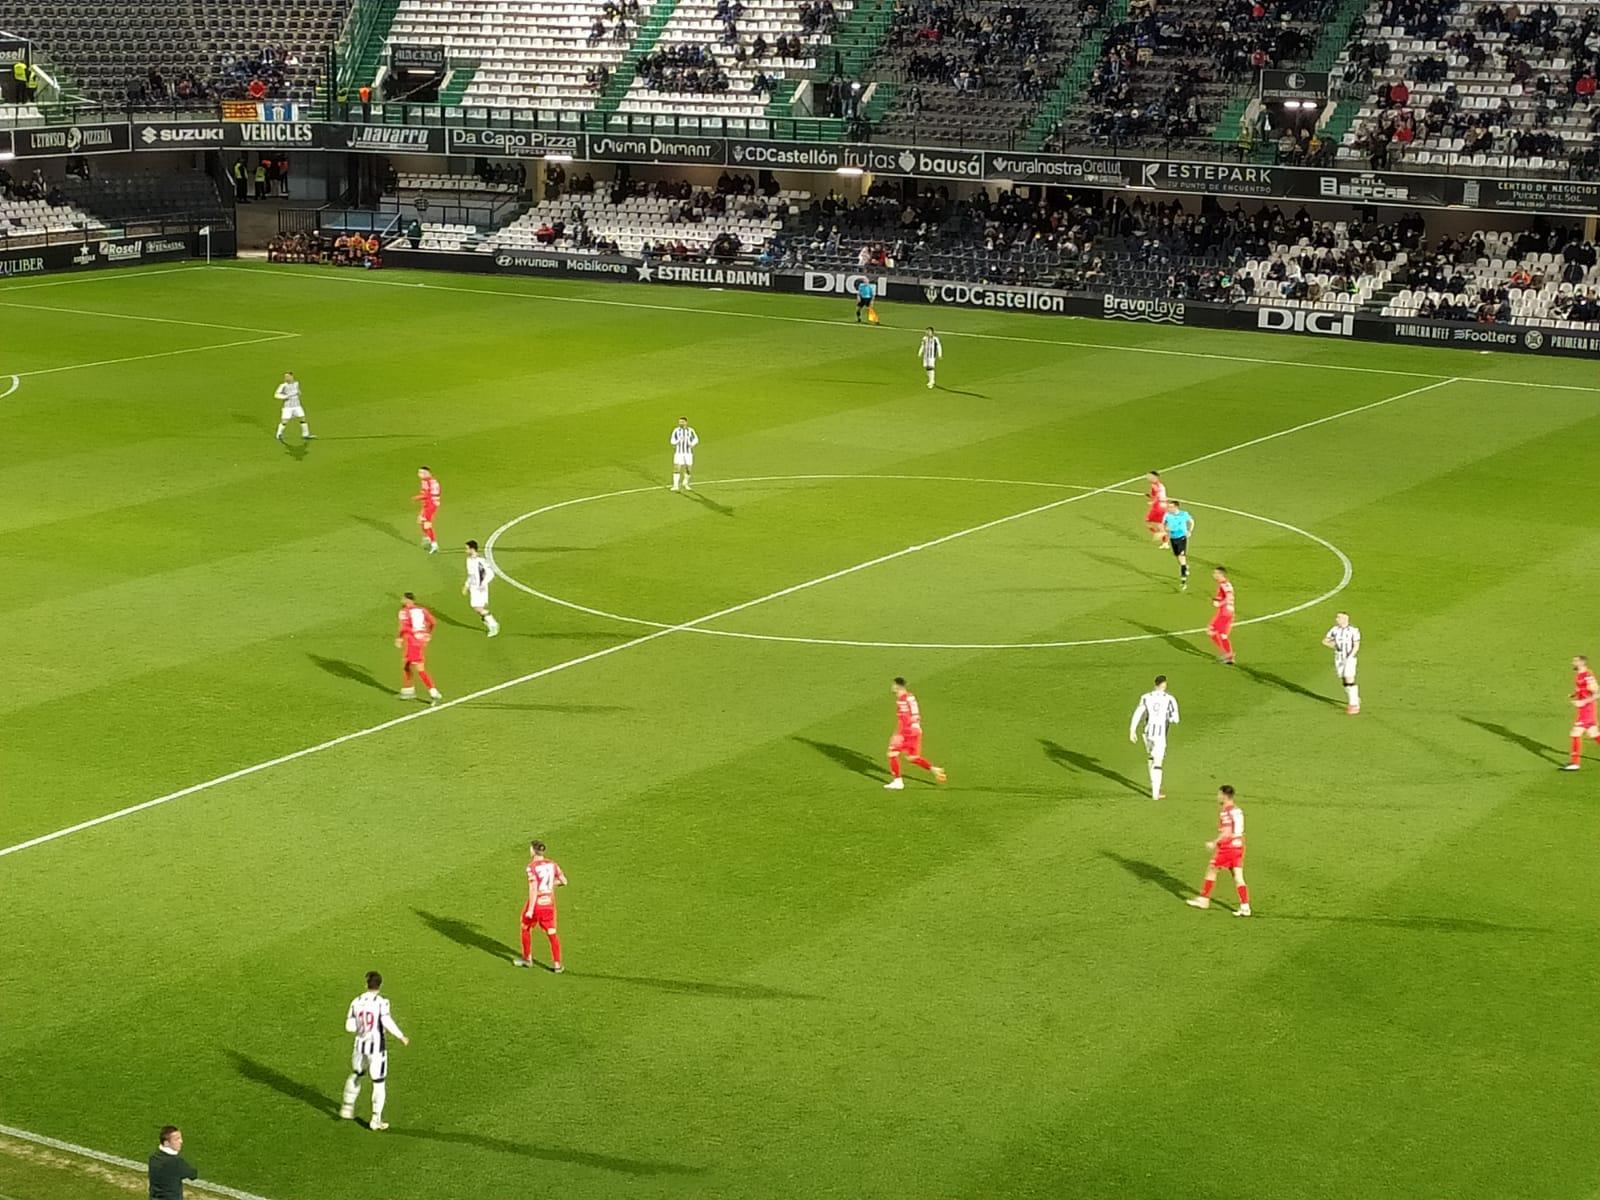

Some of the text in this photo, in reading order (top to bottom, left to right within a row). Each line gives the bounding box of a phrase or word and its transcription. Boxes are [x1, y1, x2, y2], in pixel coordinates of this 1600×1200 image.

[160, 128, 224, 141] SUZUKI
[240, 124, 313, 141] VEHICLES
[453, 129, 577, 152] Da Capo Pizza
[745, 147, 838, 165] CDCastellón
[844, 148, 980, 176] frutas bausá
[1007, 158, 1083, 176] ruralnostra
[1167, 164, 1272, 183] ESTEPARK
[1180, 182, 1206, 190] PUNTO
[1223, 185, 1272, 193] ENCUENTRO
[1498, 182, 1598, 194] CENTRO DE NEGOCIOS
[108, 240, 142, 255] Rosell
[514, 257, 559, 268] HYUNDAI
[658, 265, 771, 286] ESTRELLA DAMM
[941, 284, 1065, 311] CDCastellón
[1104, 294, 1185, 316] Bravoplaya
[1257, 307, 1355, 336] DIGI
[1395, 323, 1431, 338] PRIMERA
[1551, 335, 1588, 350] PRIMERA
[358, 1011, 375, 1033] 19
